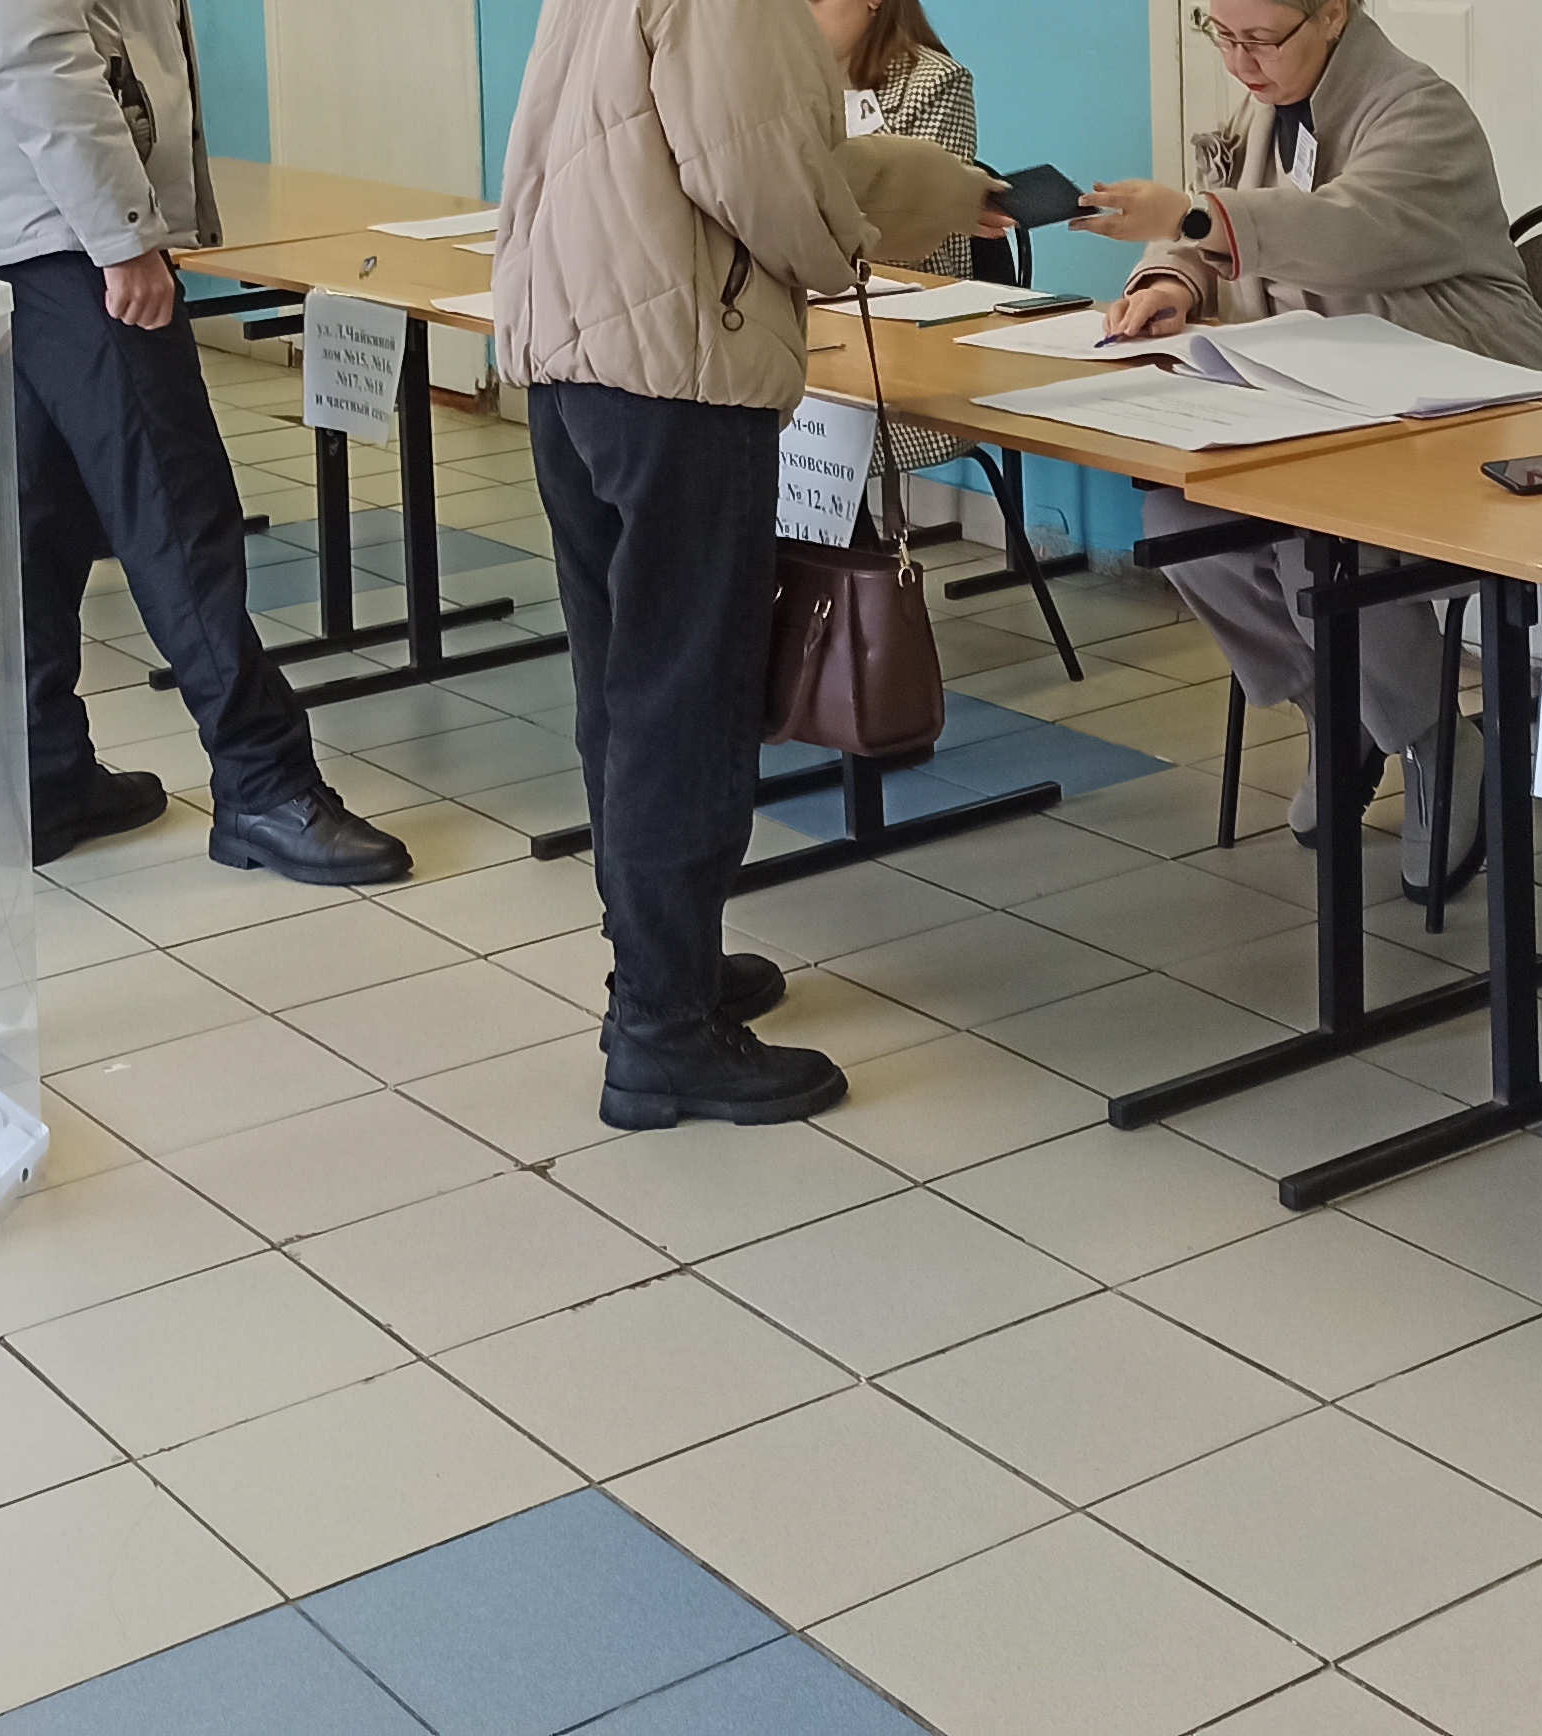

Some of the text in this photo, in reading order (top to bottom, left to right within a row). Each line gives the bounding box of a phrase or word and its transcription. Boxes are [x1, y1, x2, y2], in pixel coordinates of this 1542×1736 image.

[322, 348, 341, 361] дом
[315, 394, 323, 406] и
[325, 396, 370, 418] частный
[791, 417, 827, 438] м-он
[779, 450, 855, 483] уковского
[786, 483, 803, 505] №
